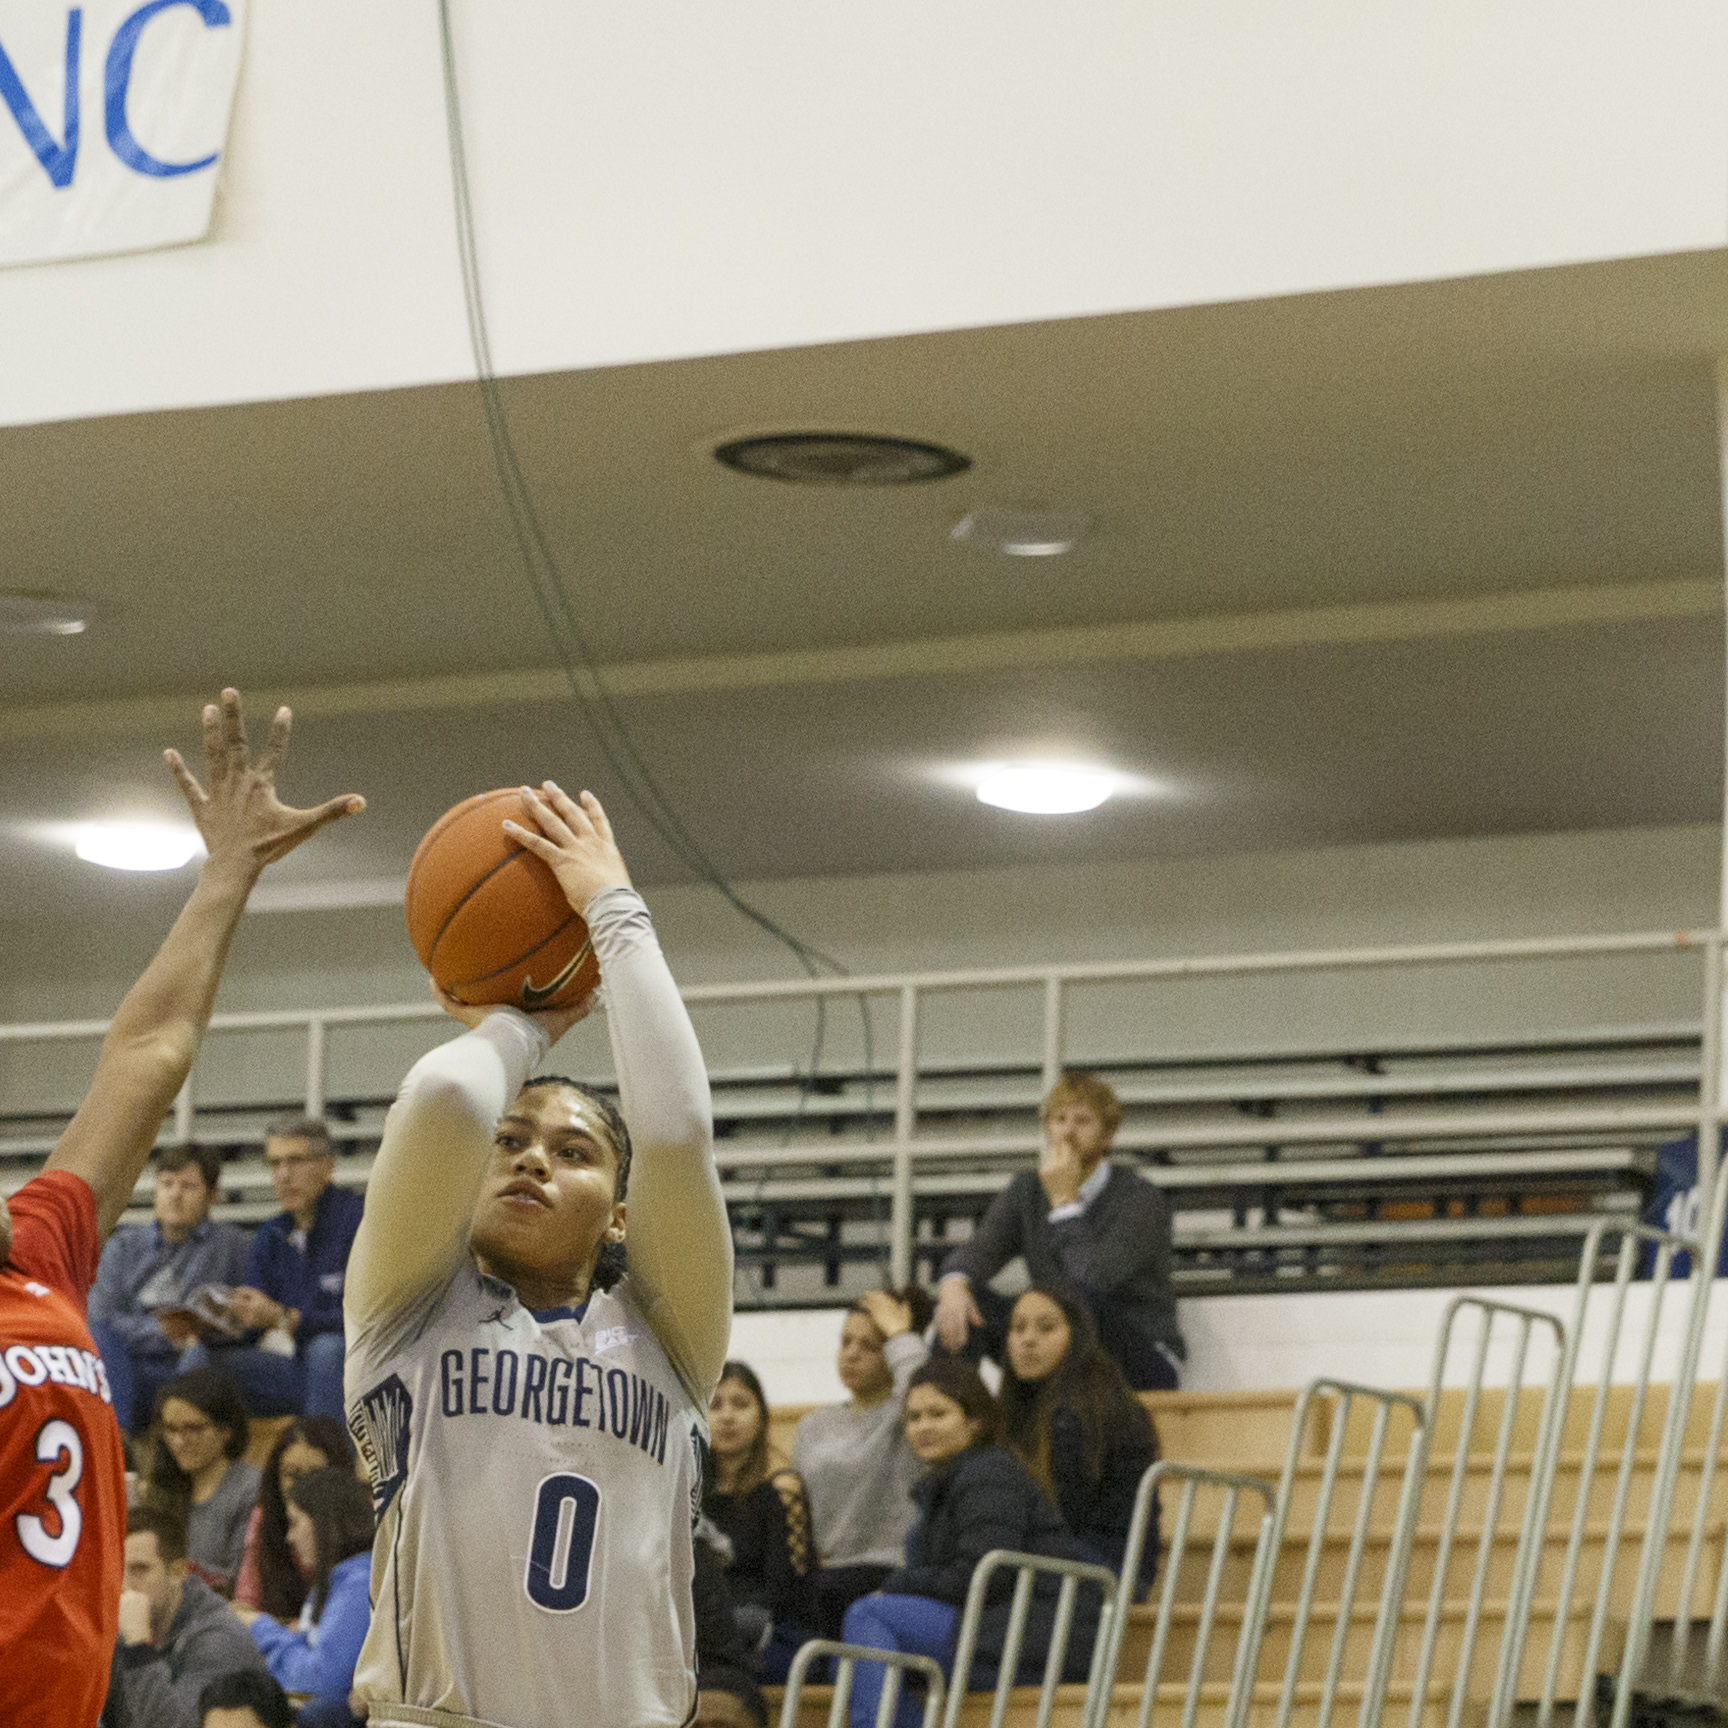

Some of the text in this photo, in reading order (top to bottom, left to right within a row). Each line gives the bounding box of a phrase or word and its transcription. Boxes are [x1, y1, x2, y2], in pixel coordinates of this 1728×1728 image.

[440, 1348, 670, 1467] GEORGETOWN
[16, 1417, 83, 1569] 3
[524, 1470, 603, 1615] 0
